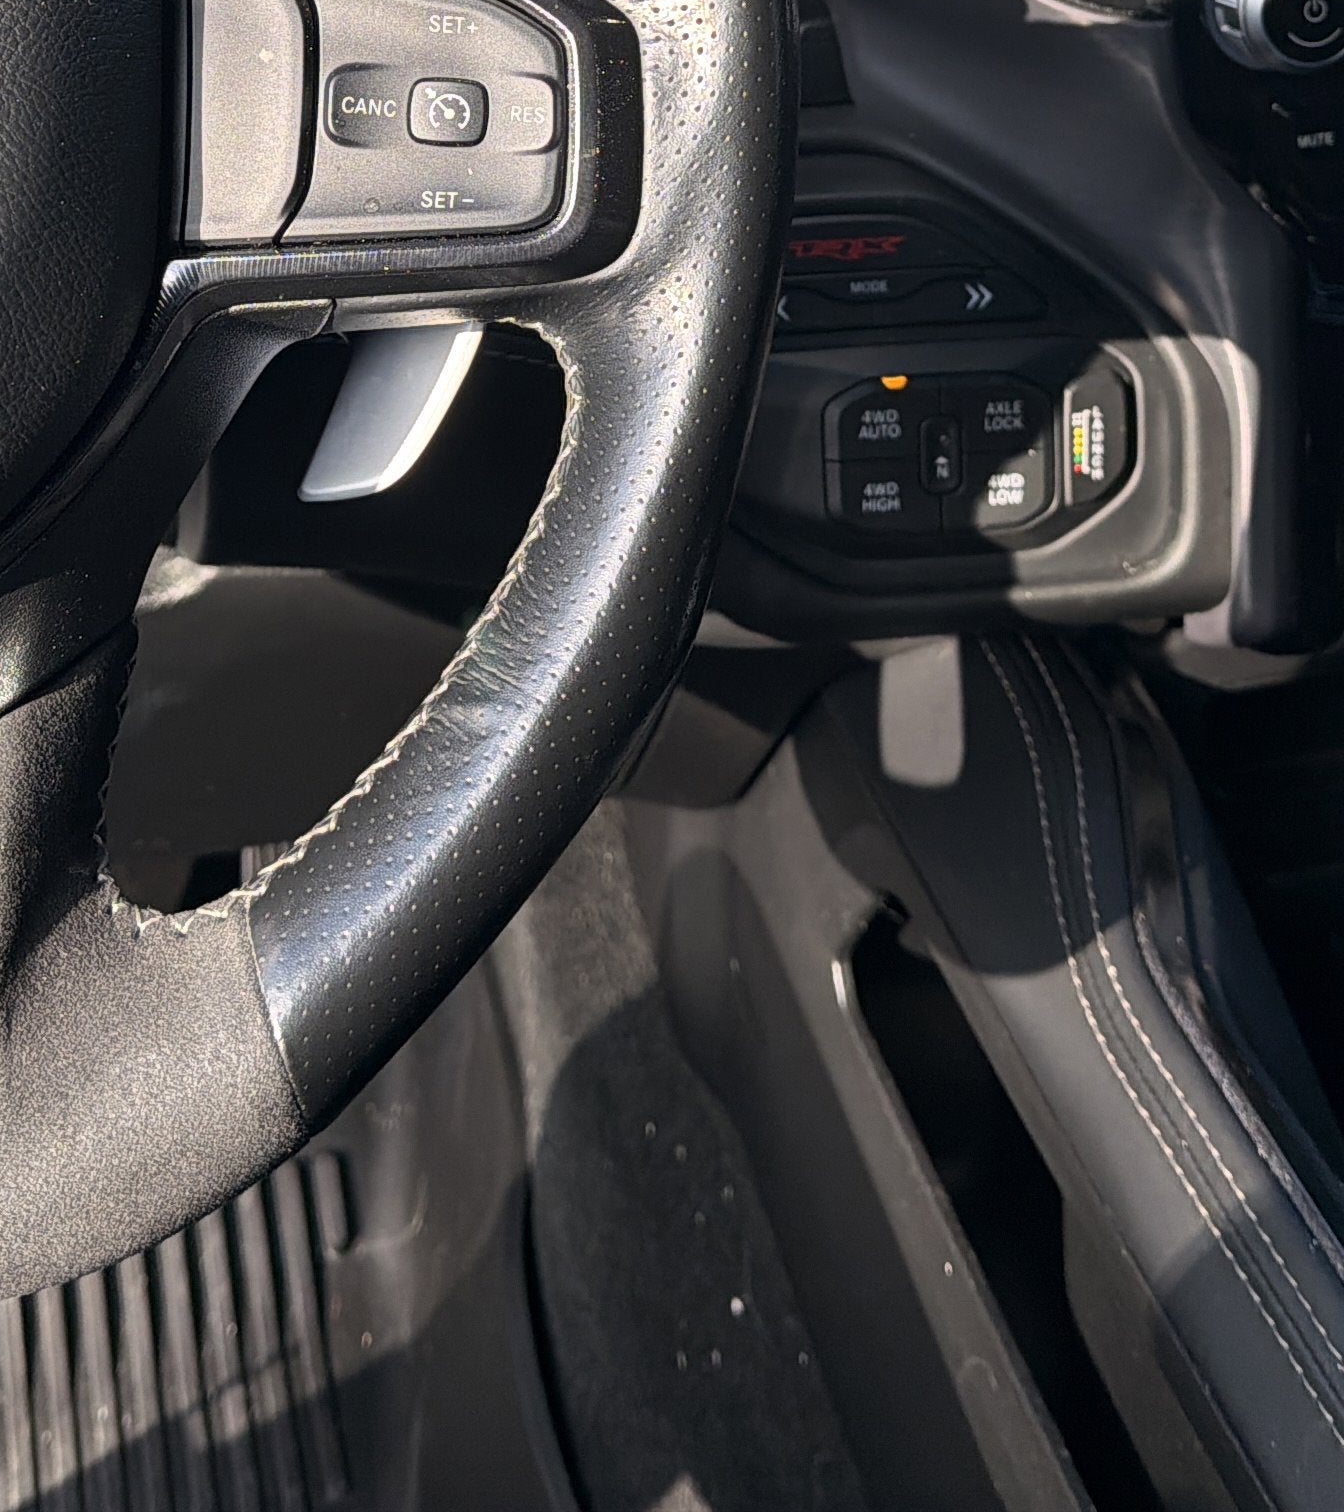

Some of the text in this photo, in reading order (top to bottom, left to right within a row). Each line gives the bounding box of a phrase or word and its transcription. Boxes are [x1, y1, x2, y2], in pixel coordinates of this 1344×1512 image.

[341, 96, 397, 118] CANC
[510, 105, 545, 123] RES
[850, 280, 888, 294] MODE
[861, 408, 900, 424] 4WD
[985, 400, 1024, 415] AXLE
[859, 423, 902, 439] AUTO
[984, 415, 1024, 432] LOCK
[863, 481, 900, 497] 4WD
[988, 472, 1025, 489] 4WD
[862, 496, 902, 513] HIGH
[988, 489, 1025, 507] LOW
